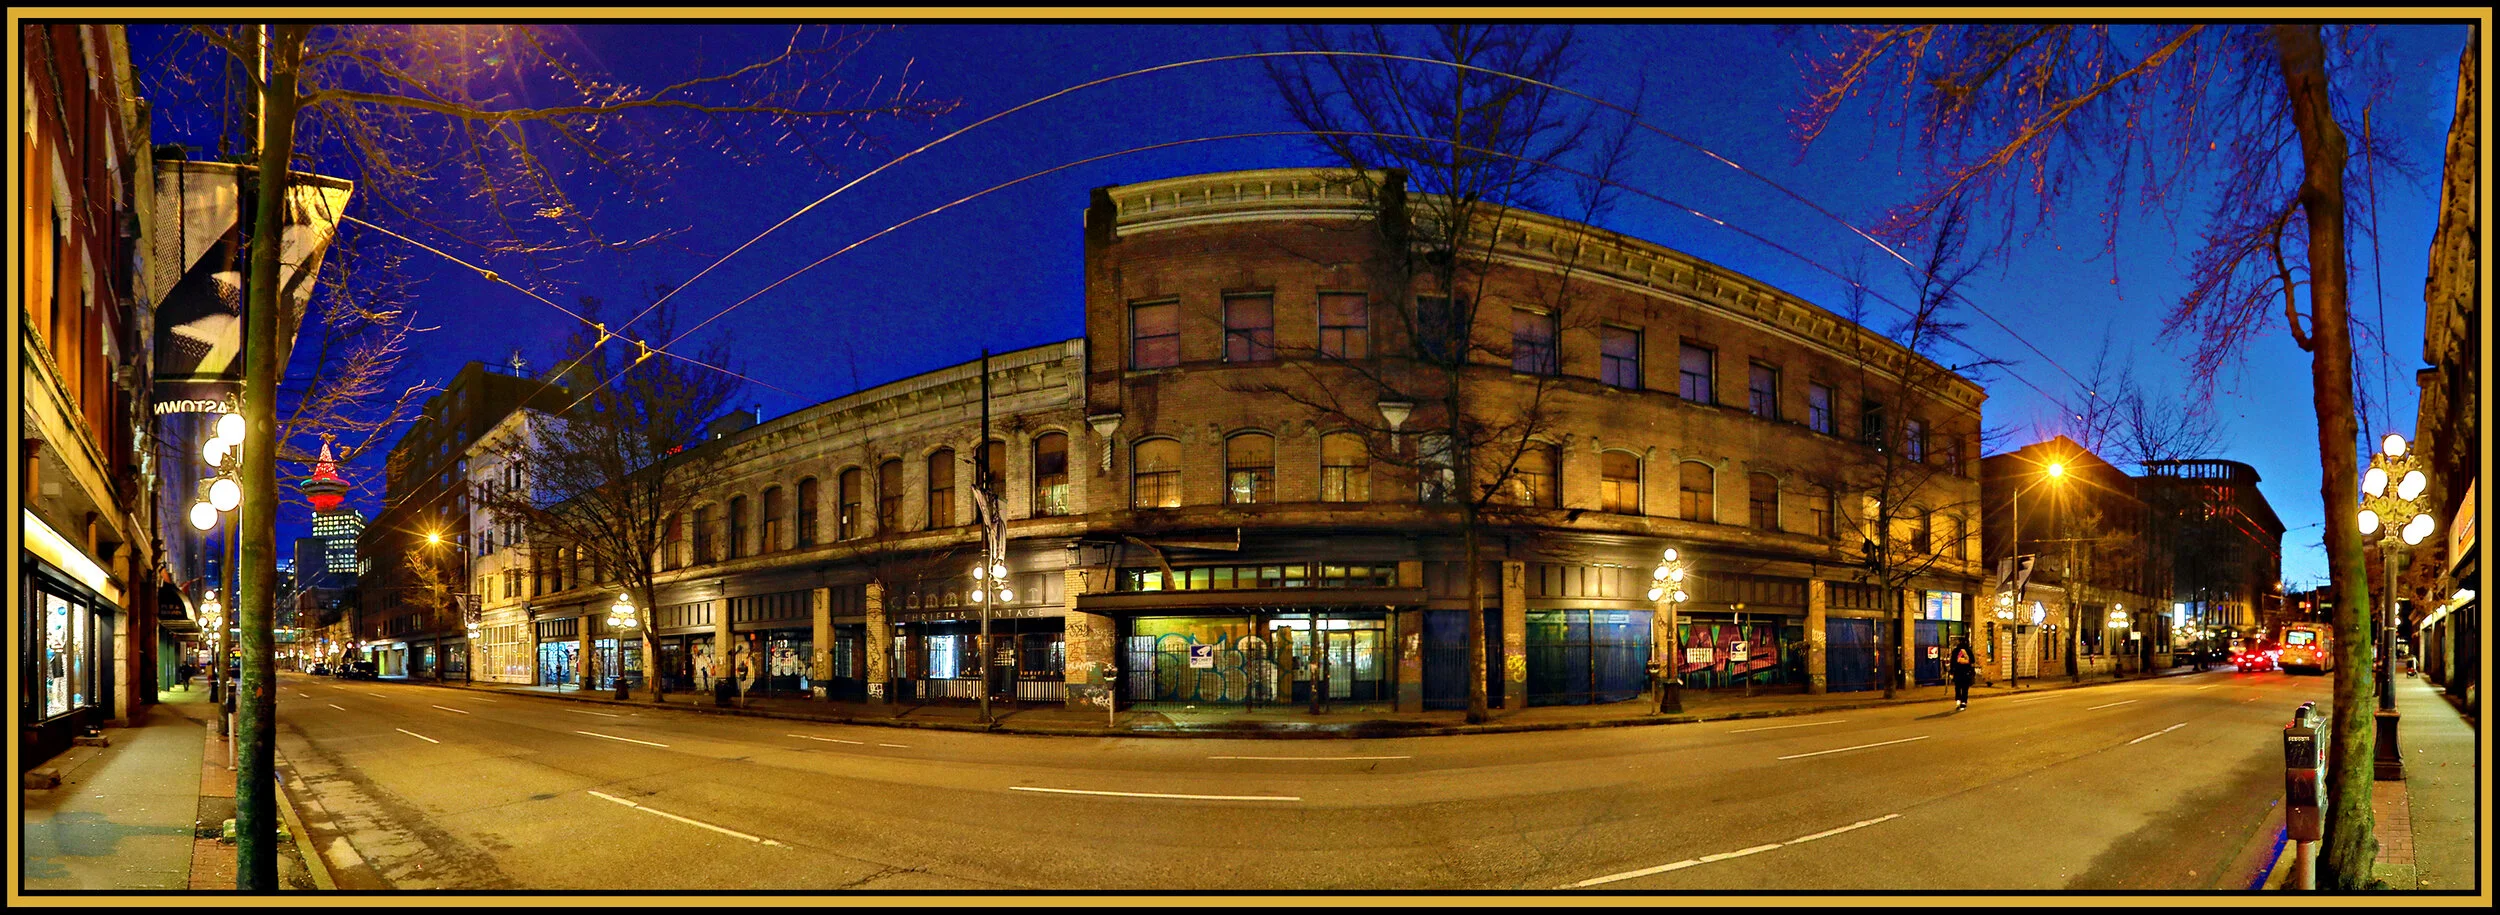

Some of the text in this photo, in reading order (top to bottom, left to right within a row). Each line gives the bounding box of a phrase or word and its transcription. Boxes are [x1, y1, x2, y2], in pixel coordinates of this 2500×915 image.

[904, 608, 1044, 622] THRIFT & VNTAGE
